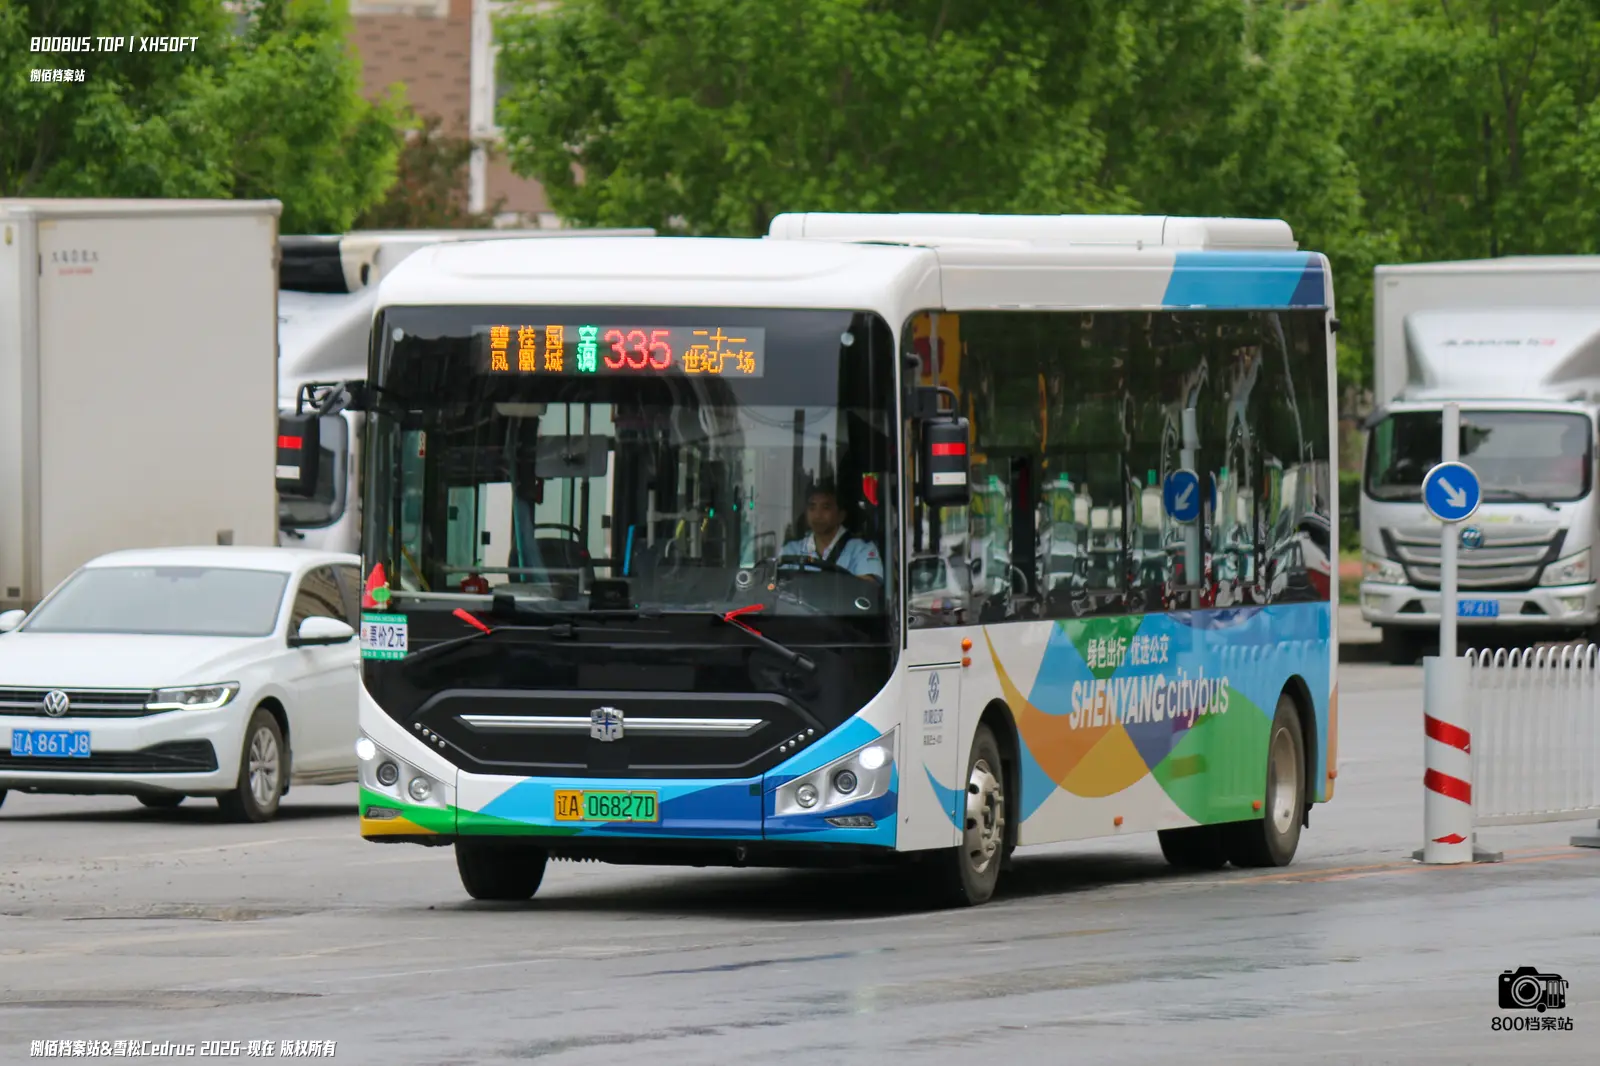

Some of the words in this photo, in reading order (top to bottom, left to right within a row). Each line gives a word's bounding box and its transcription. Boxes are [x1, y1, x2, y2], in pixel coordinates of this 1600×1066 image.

[577, 325, 598, 372] 空调
[603, 329, 672, 369] 335
[1086, 637, 1127, 669] 绿色出行
[1130, 633, 1170, 666] 优选公交
